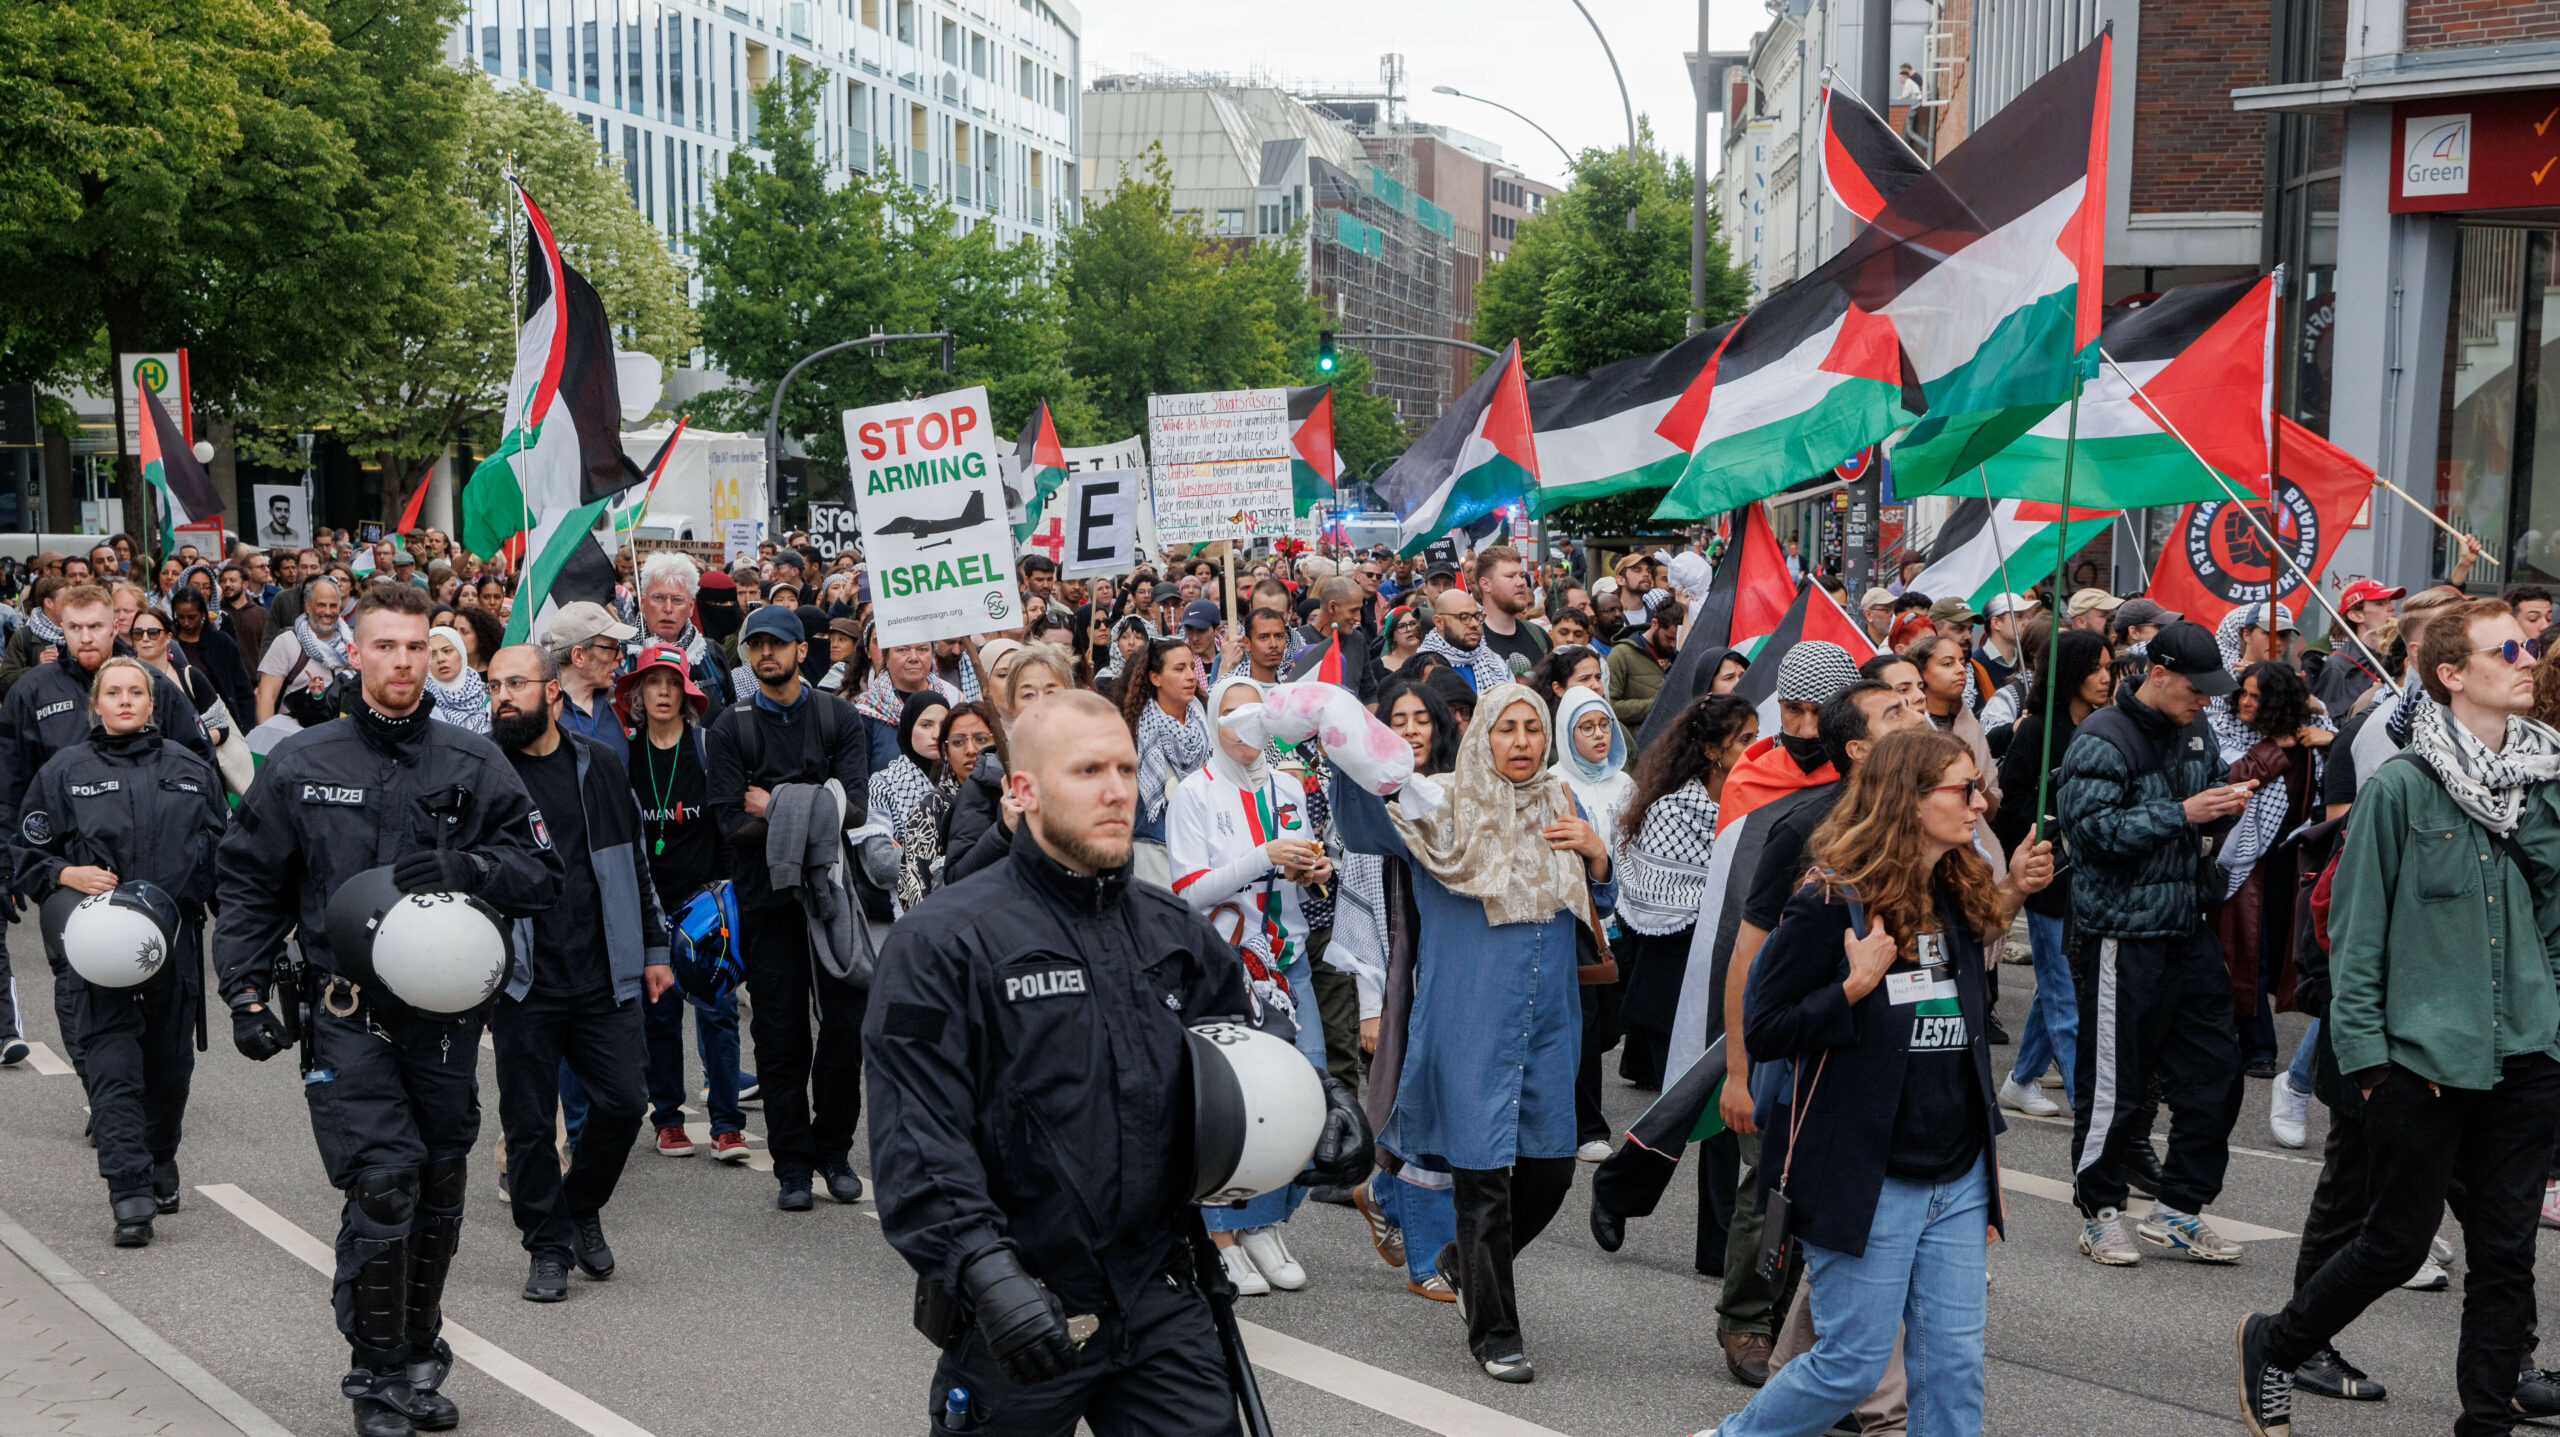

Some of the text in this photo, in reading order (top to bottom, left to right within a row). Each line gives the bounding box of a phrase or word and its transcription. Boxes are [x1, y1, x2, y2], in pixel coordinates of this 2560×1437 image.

[2407, 164, 2464, 183] Green
[1156, 396, 1175, 417] Die
[1180, 396, 1207, 414] echte
[858, 406, 977, 461] STOP
[1150, 417, 1163, 433] Die
[1186, 416, 1198, 430] des
[867, 452, 986, 496] ARMING
[1077, 481, 1120, 562] E
[880, 553, 1004, 598] ISRAEL
[887, 607, 963, 627] palestinecampaign.org
[36, 699, 74, 720] POLIZEI
[71, 780, 120, 796] POLZEI
[303, 784, 363, 804] POLIZEI
[1005, 968, 1087, 1001] POLIZEI
